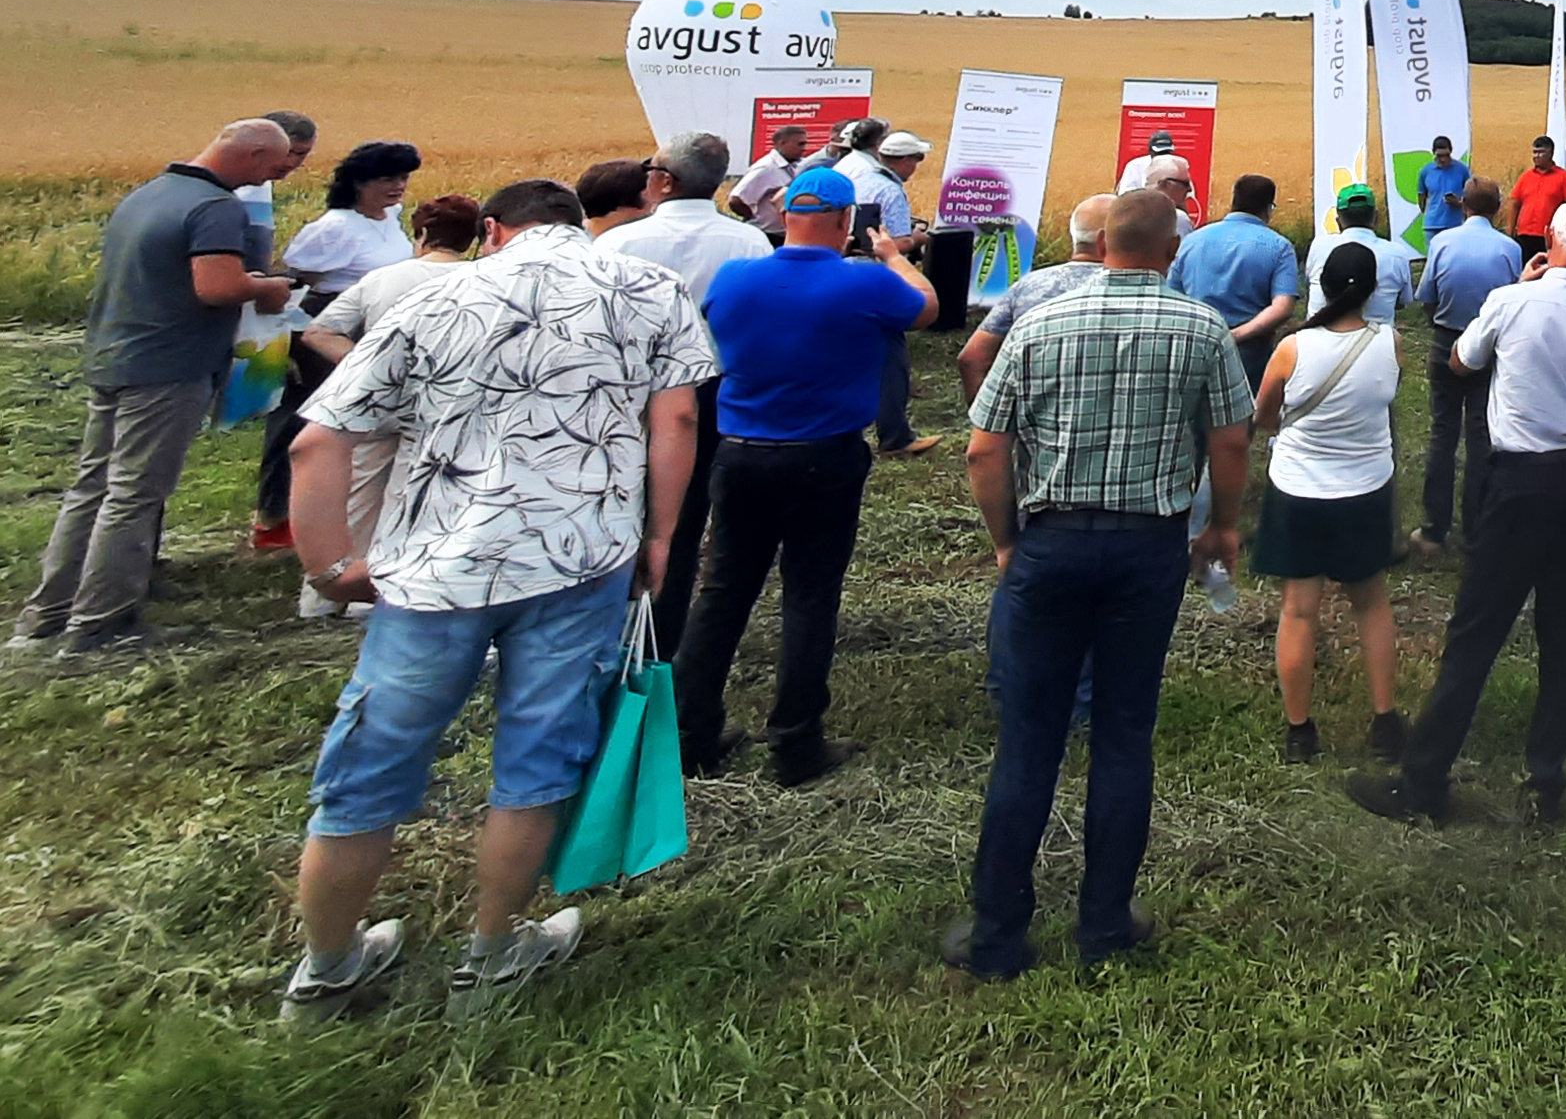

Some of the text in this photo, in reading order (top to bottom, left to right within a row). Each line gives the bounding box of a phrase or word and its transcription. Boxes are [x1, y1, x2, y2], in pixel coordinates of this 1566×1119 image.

[637, 26, 761, 60] avgust
[666, 64, 741, 77] protection
[805, 77, 838, 86] avgust
[950, 176, 1011, 190] Контроль
[948, 189, 1010, 201] инфекции
[946, 202, 993, 212] в почве
[944, 214, 951, 222] и
[954, 215, 969, 223] на
